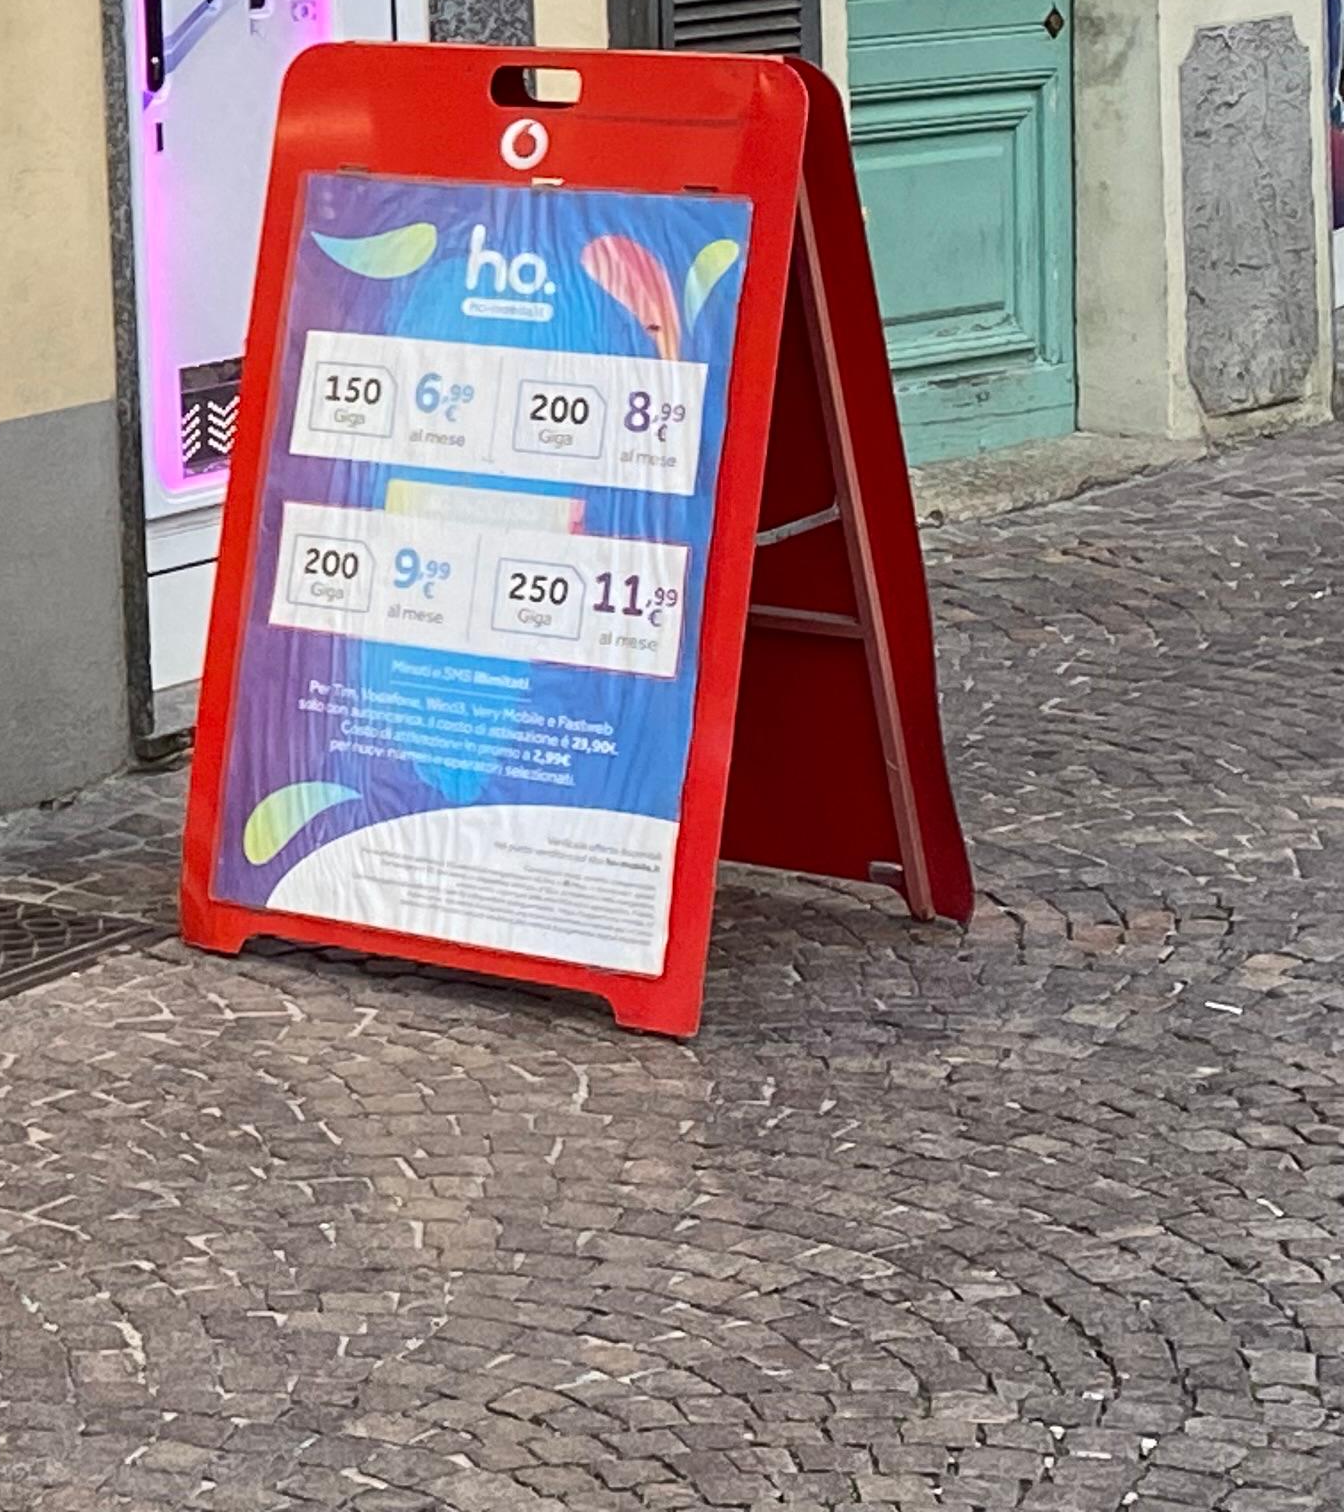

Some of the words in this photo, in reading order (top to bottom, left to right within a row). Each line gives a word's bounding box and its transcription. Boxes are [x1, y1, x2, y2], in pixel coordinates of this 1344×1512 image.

[464, 224, 556, 296] ho.
[325, 375, 381, 405] 150
[334, 408, 365, 428] Giga
[529, 393, 589, 425] 200
[409, 428, 423, 443] al
[425, 431, 465, 448] mese
[538, 428, 573, 449] Giga
[619, 449, 634, 463] al
[304, 548, 358, 579] 200
[310, 581, 344, 602] Giga
[508, 572, 569, 606] 250
[387, 604, 401, 619] al
[402, 608, 444, 624] mese
[517, 608, 552, 628] Giga
[472, 704, 500, 722] Very
[501, 709, 546, 727] Mobile
[547, 717, 557, 728] e
[558, 715, 614, 737] Fastweb
